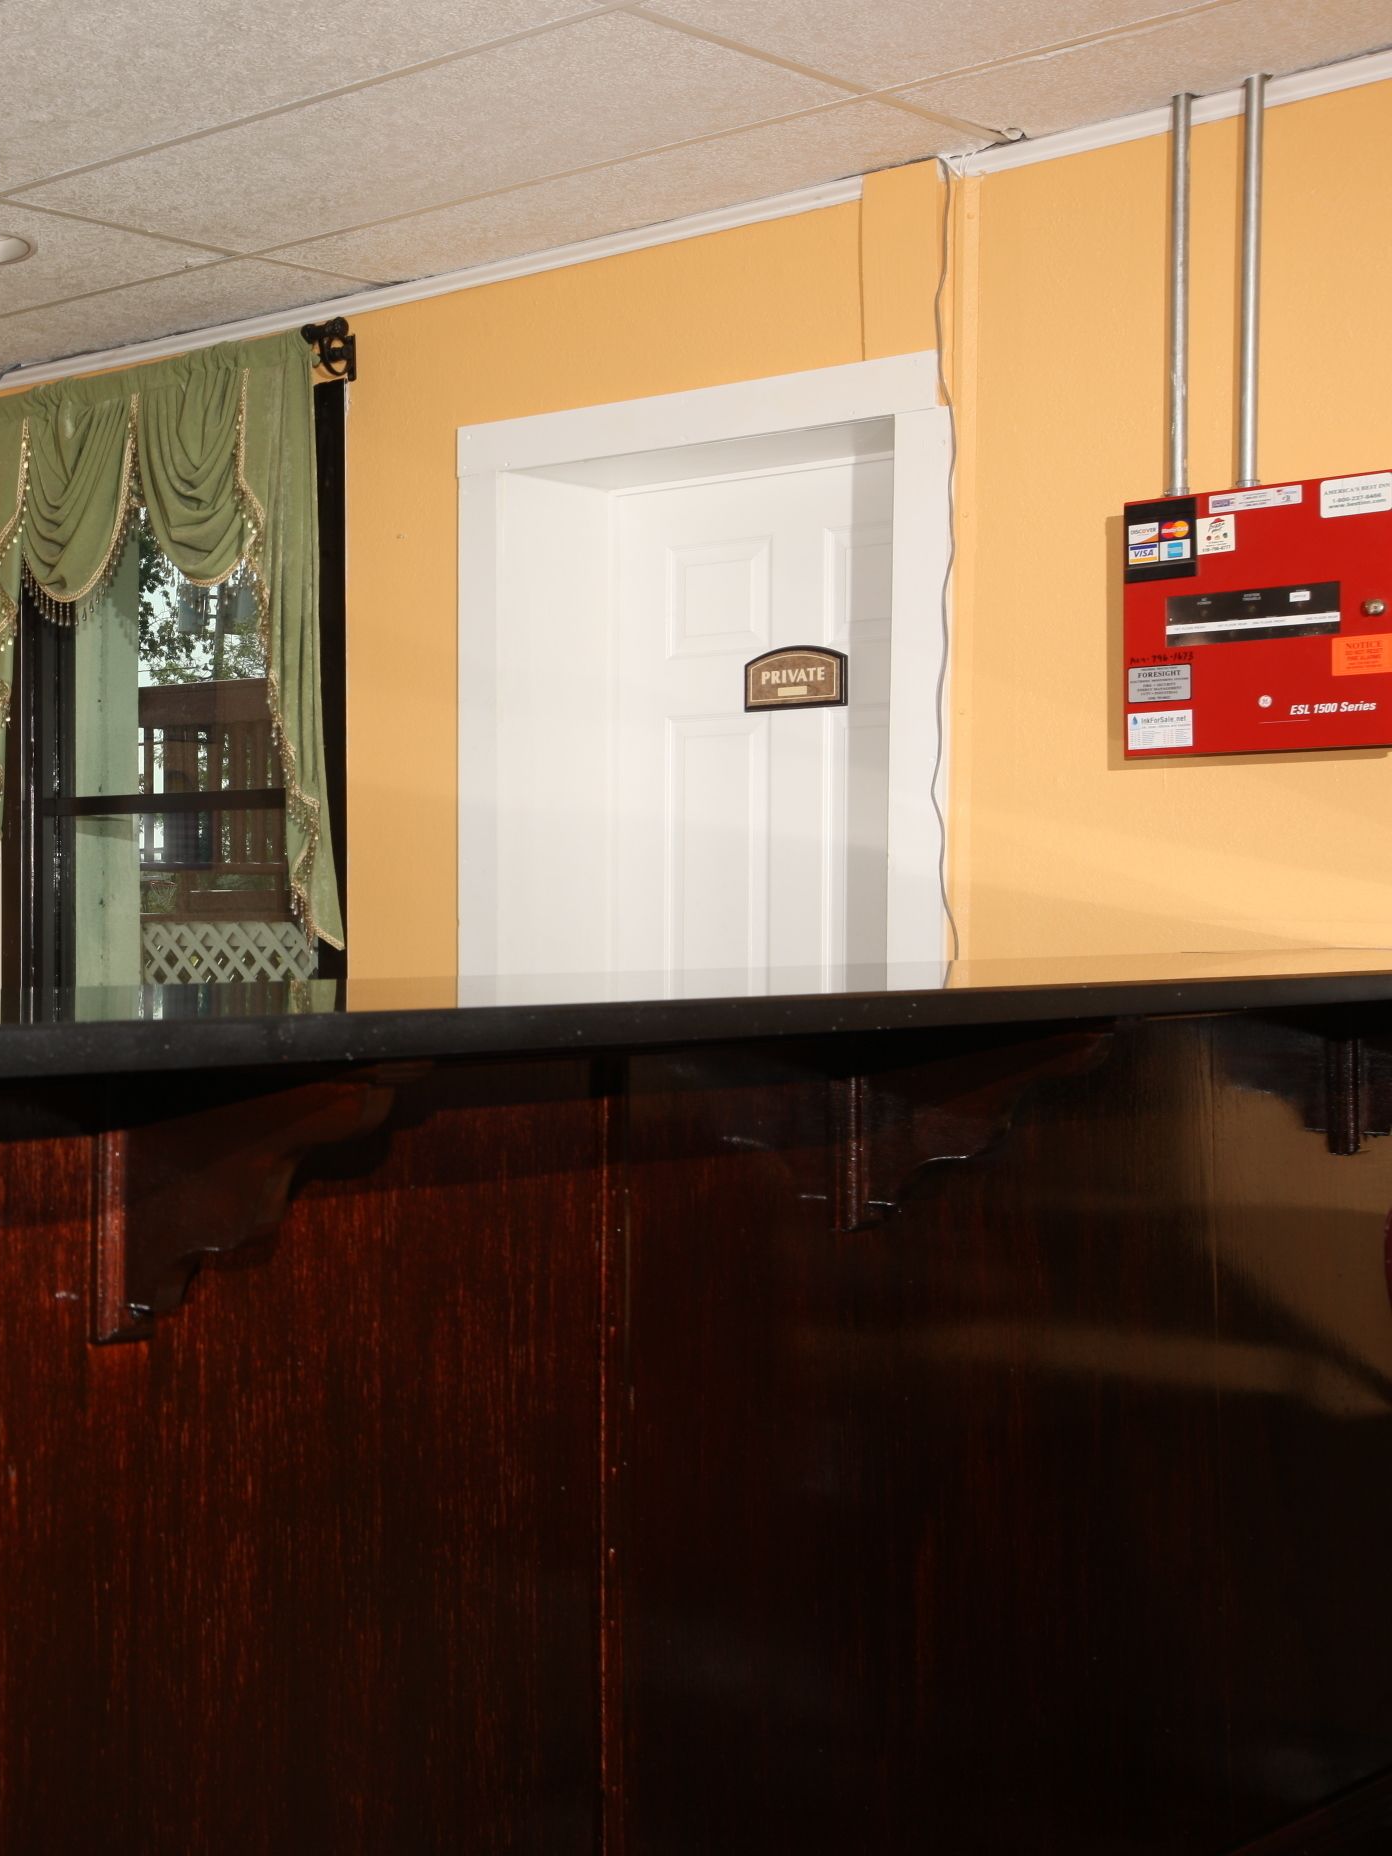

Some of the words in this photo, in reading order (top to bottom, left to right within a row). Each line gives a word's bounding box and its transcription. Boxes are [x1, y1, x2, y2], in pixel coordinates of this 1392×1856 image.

[1134, 550, 1154, 558] VISA
[761, 667, 825, 685] PRIVATE
[1138, 670, 1181, 678] FORESIGHT
[1290, 704, 1310, 716] ESL
[1314, 702, 1338, 714] 1500
[1340, 700, 1376, 712] Series
